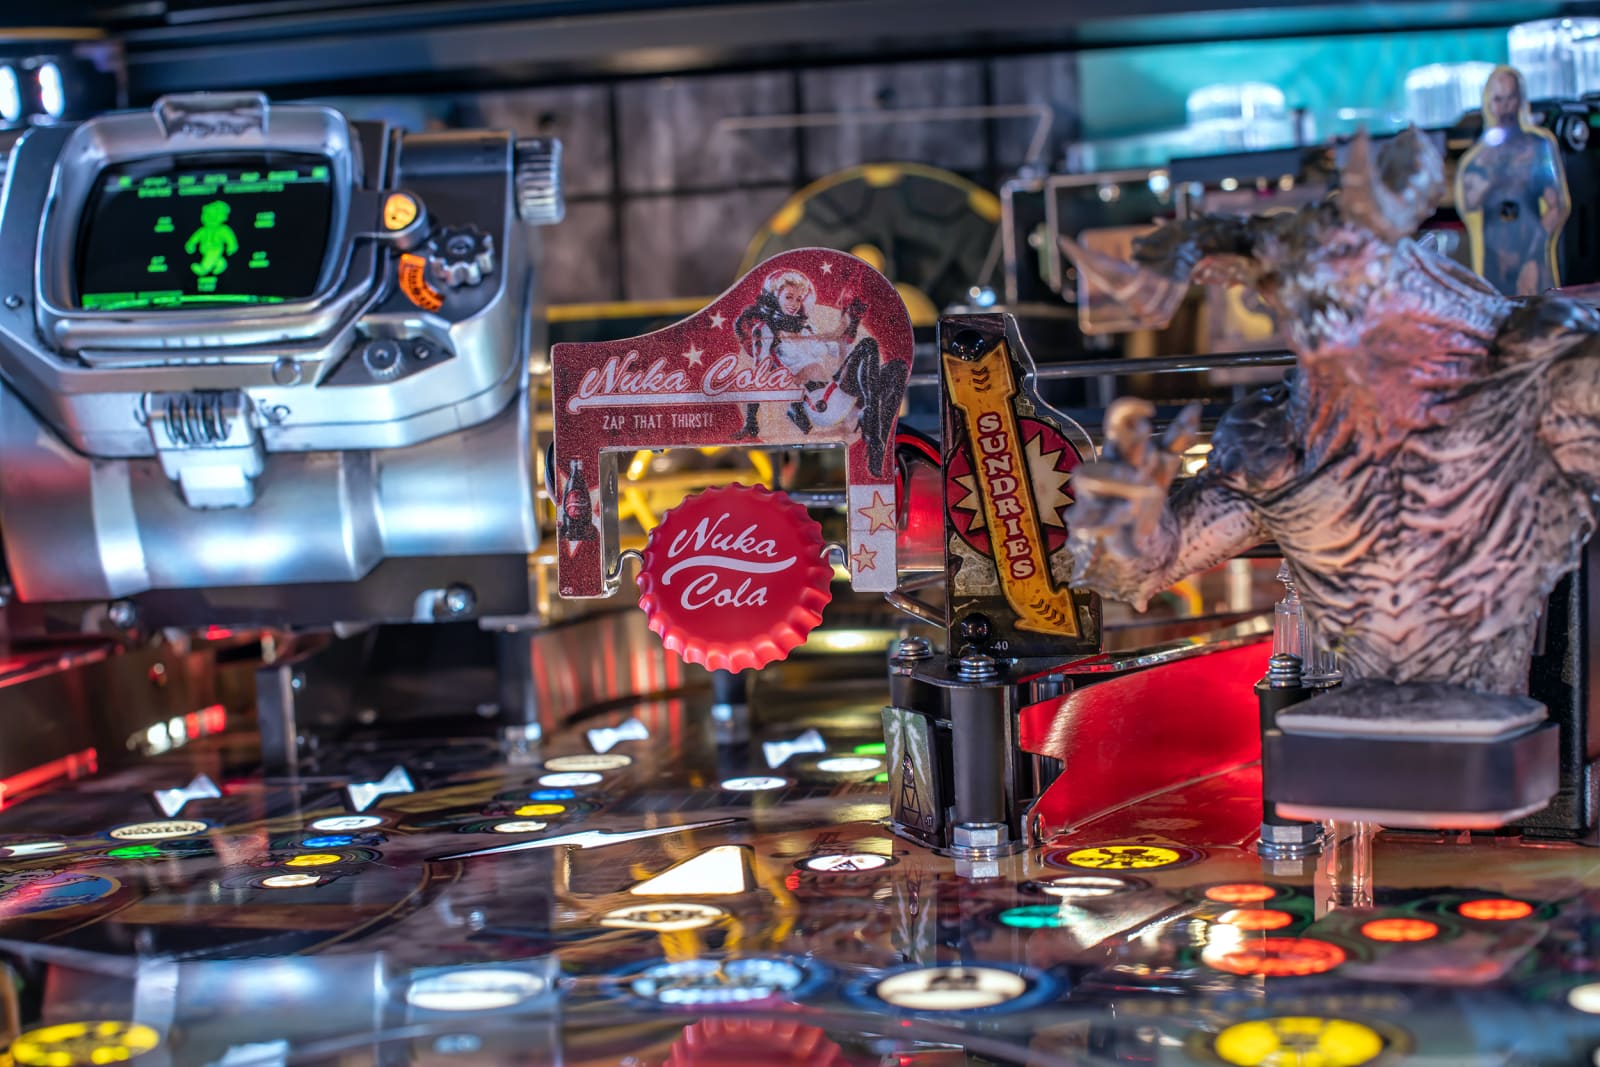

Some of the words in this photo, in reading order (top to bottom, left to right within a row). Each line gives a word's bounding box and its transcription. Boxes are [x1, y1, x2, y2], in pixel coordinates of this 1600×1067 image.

[579, 350, 690, 399] Nuka
[702, 354, 793, 396] Cola
[603, 414, 625, 430] ZAP
[634, 413, 662, 429] THAT
[671, 412, 713, 428] THIRST!
[978, 412, 1035, 580] SUNDRIES
[667, 512, 778, 558] Nuka
[680, 572, 768, 610] Cola
